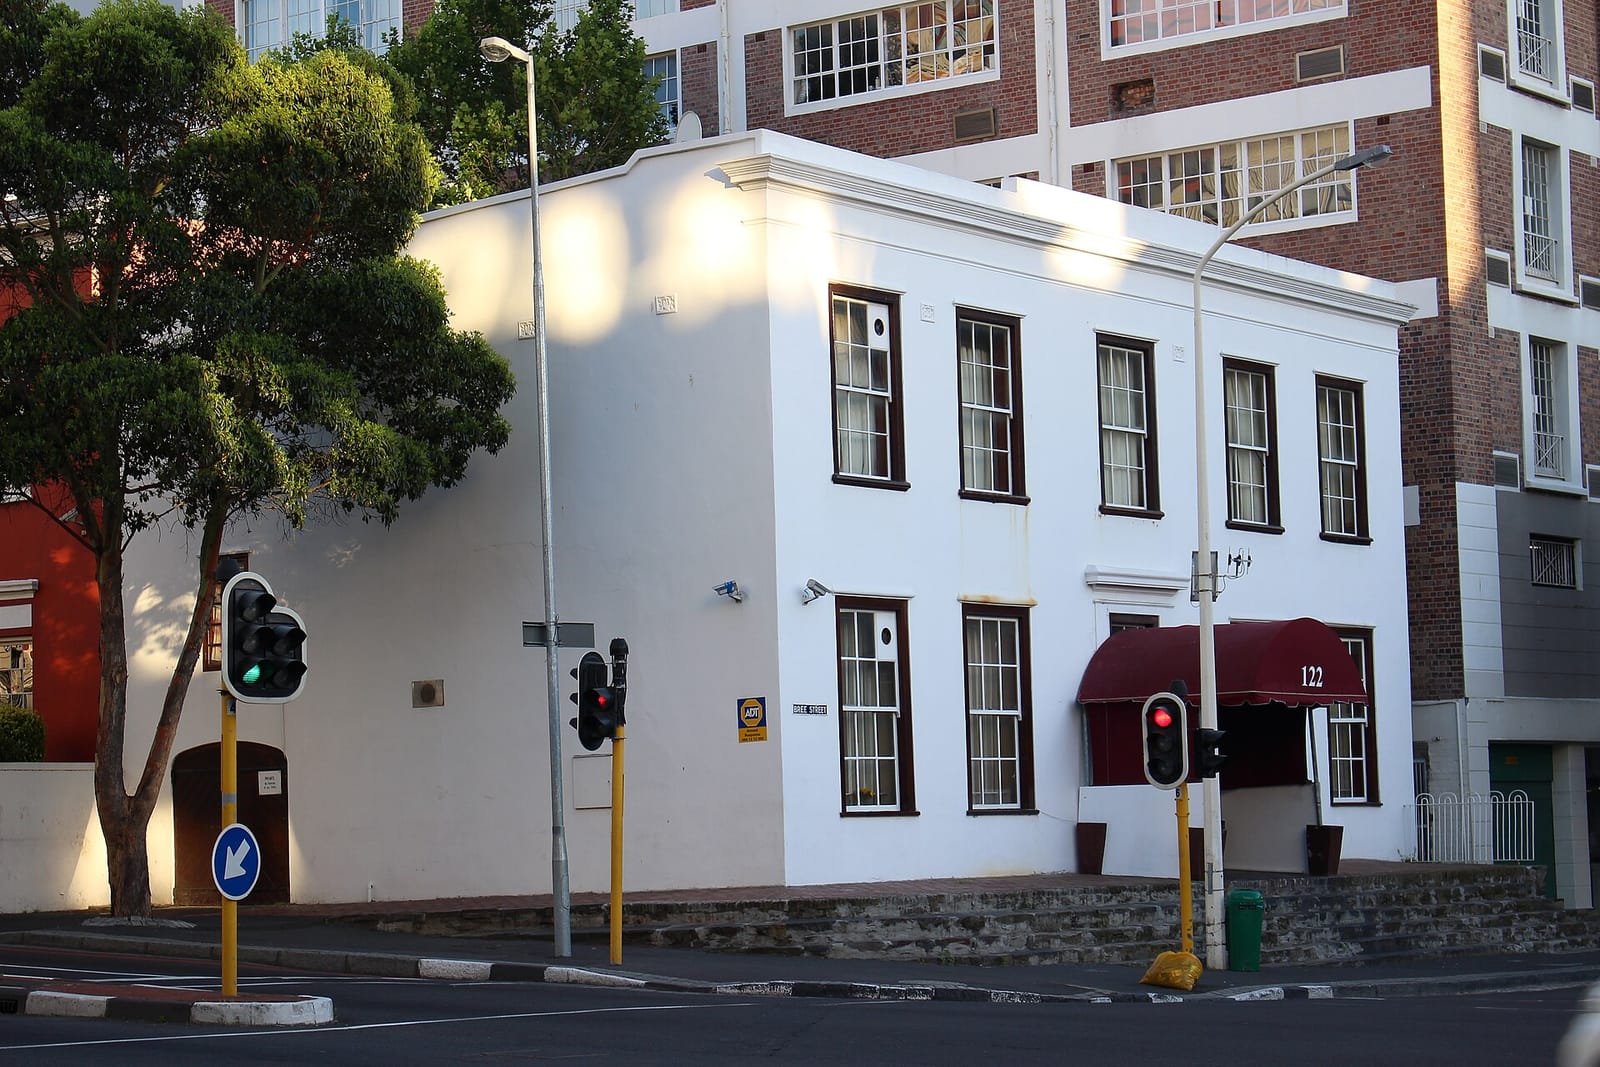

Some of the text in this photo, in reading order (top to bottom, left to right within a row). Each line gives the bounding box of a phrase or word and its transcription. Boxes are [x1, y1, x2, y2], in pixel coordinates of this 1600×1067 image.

[1301, 665, 1323, 687] 122
[744, 707, 759, 718] ADT
[793, 705, 827, 714] BREE STREET
